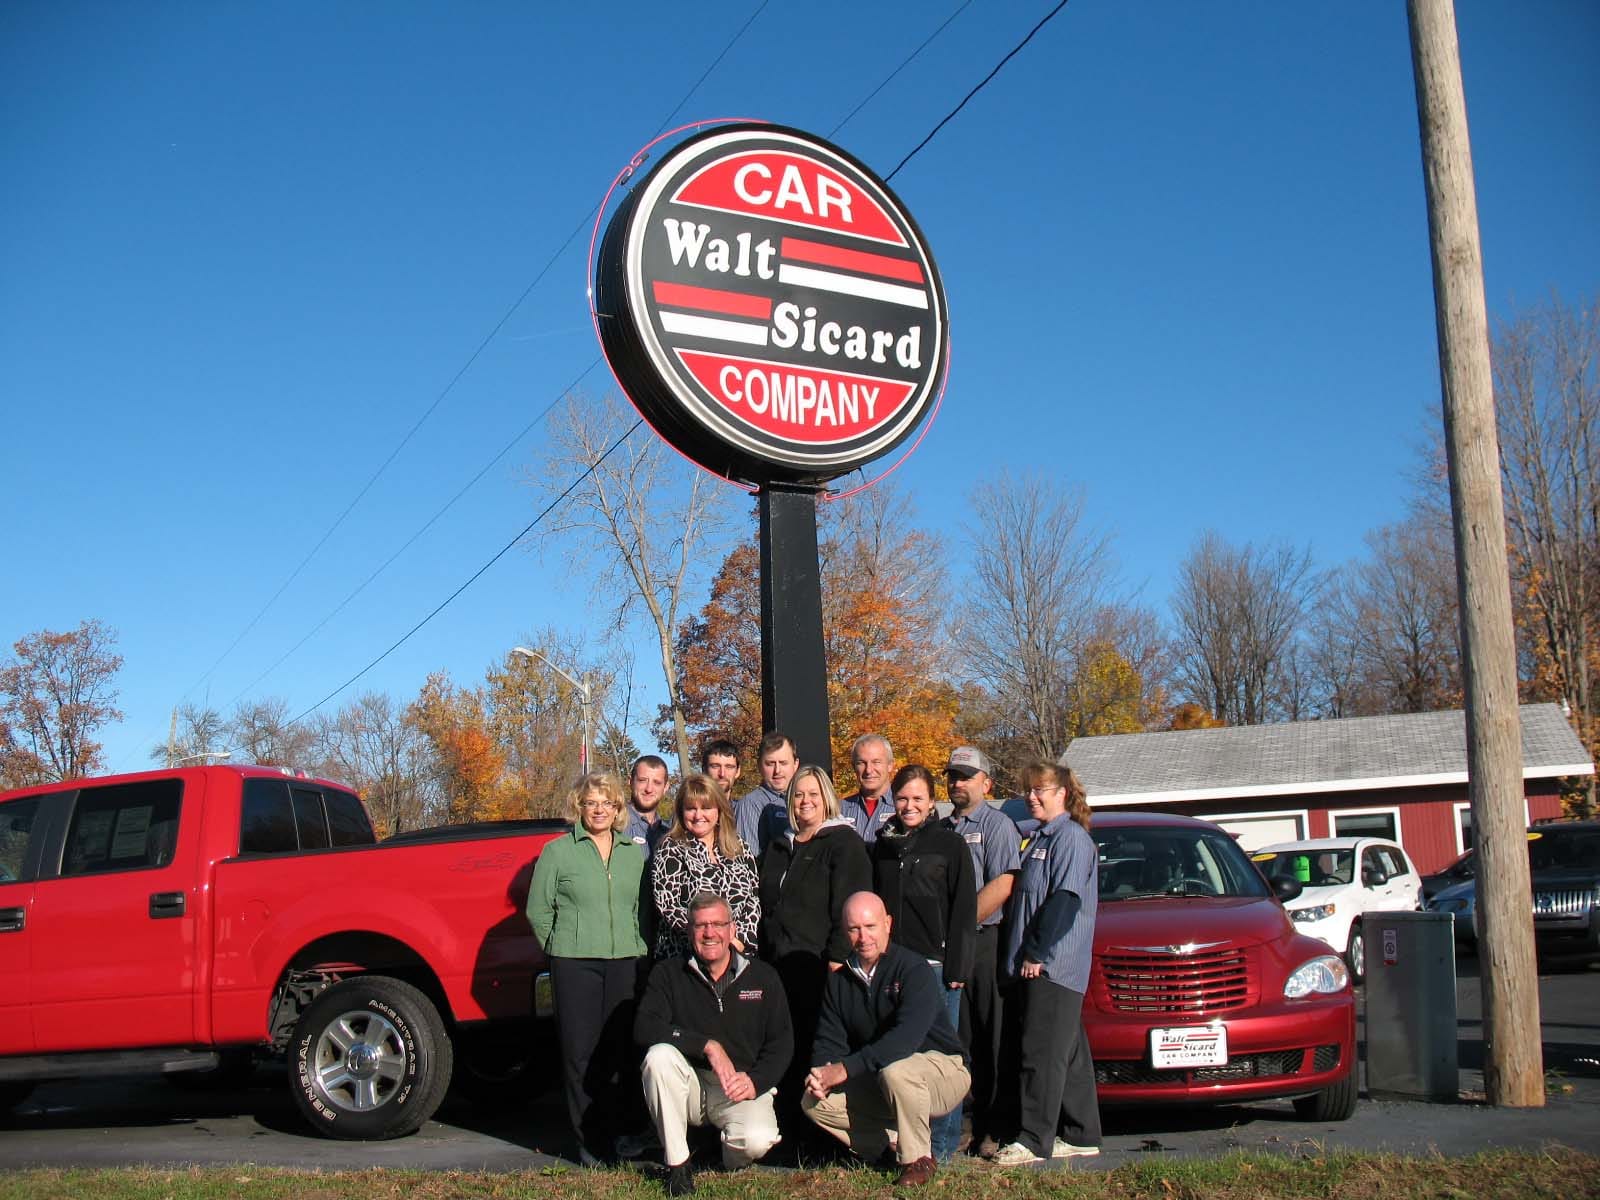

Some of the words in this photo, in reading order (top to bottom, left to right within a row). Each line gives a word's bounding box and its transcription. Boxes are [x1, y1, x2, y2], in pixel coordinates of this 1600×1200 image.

[733, 162, 854, 223] CAR
[662, 218, 776, 280] Walt
[770, 301, 921, 369] Sicard
[718, 365, 880, 427] COMPANY
[1161, 1035, 1185, 1043] Walt
[1183, 1042, 1216, 1051] Sicard
[298, 1034, 337, 1121] GENERAL
